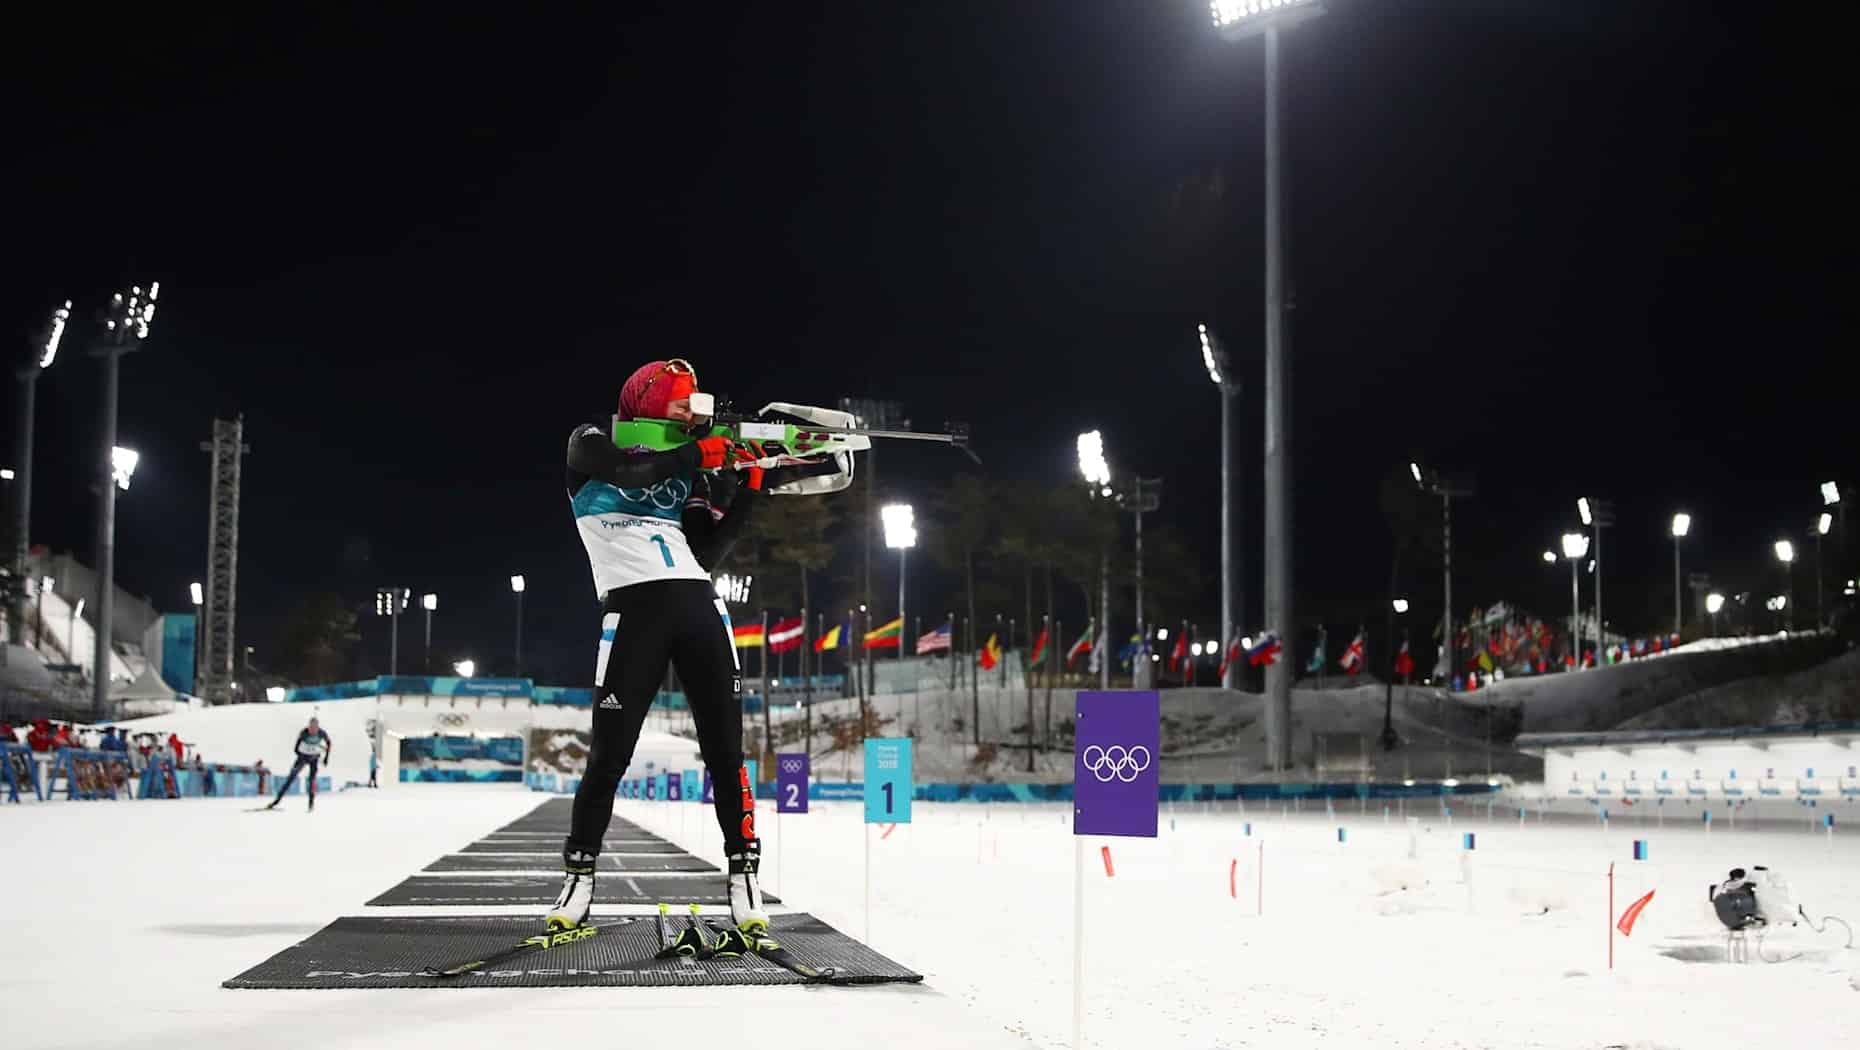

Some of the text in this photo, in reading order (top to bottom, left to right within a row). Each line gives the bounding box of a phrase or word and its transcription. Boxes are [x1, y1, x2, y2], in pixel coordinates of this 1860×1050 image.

[649, 534, 675, 568] 1
[785, 783, 799, 808] 2
[881, 782, 893, 814] 1
